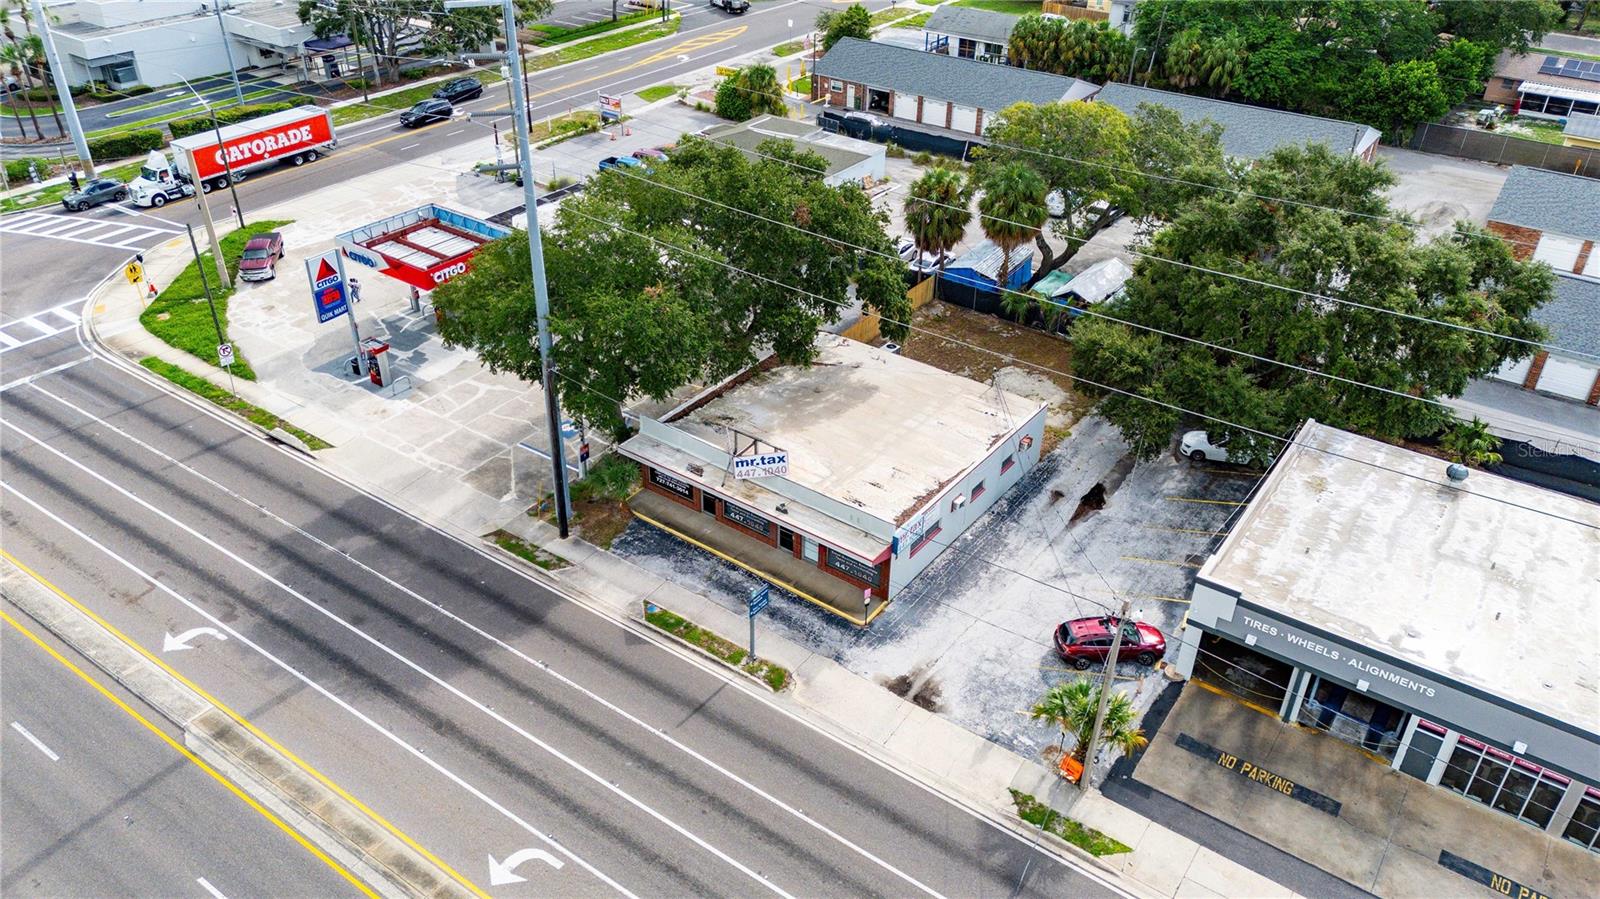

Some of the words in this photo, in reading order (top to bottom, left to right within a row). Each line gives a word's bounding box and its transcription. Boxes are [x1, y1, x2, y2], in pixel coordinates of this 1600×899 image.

[215, 125, 312, 165] GATORADE
[317, 275, 339, 288] CITGO
[433, 262, 466, 283] CITGO
[333, 304, 347, 316] MART
[735, 455, 786, 468] mr.tax
[736, 465, 787, 478] 447.1040
[1243, 616, 1278, 637] TIRES
[1287, 633, 1340, 660] WHEELS
[1347, 658, 1436, 697] ALIGNMENTS
[1217, 752, 1238, 770] NO
[1240, 762, 1295, 796] PARKING
[1490, 874, 1512, 894] NO
